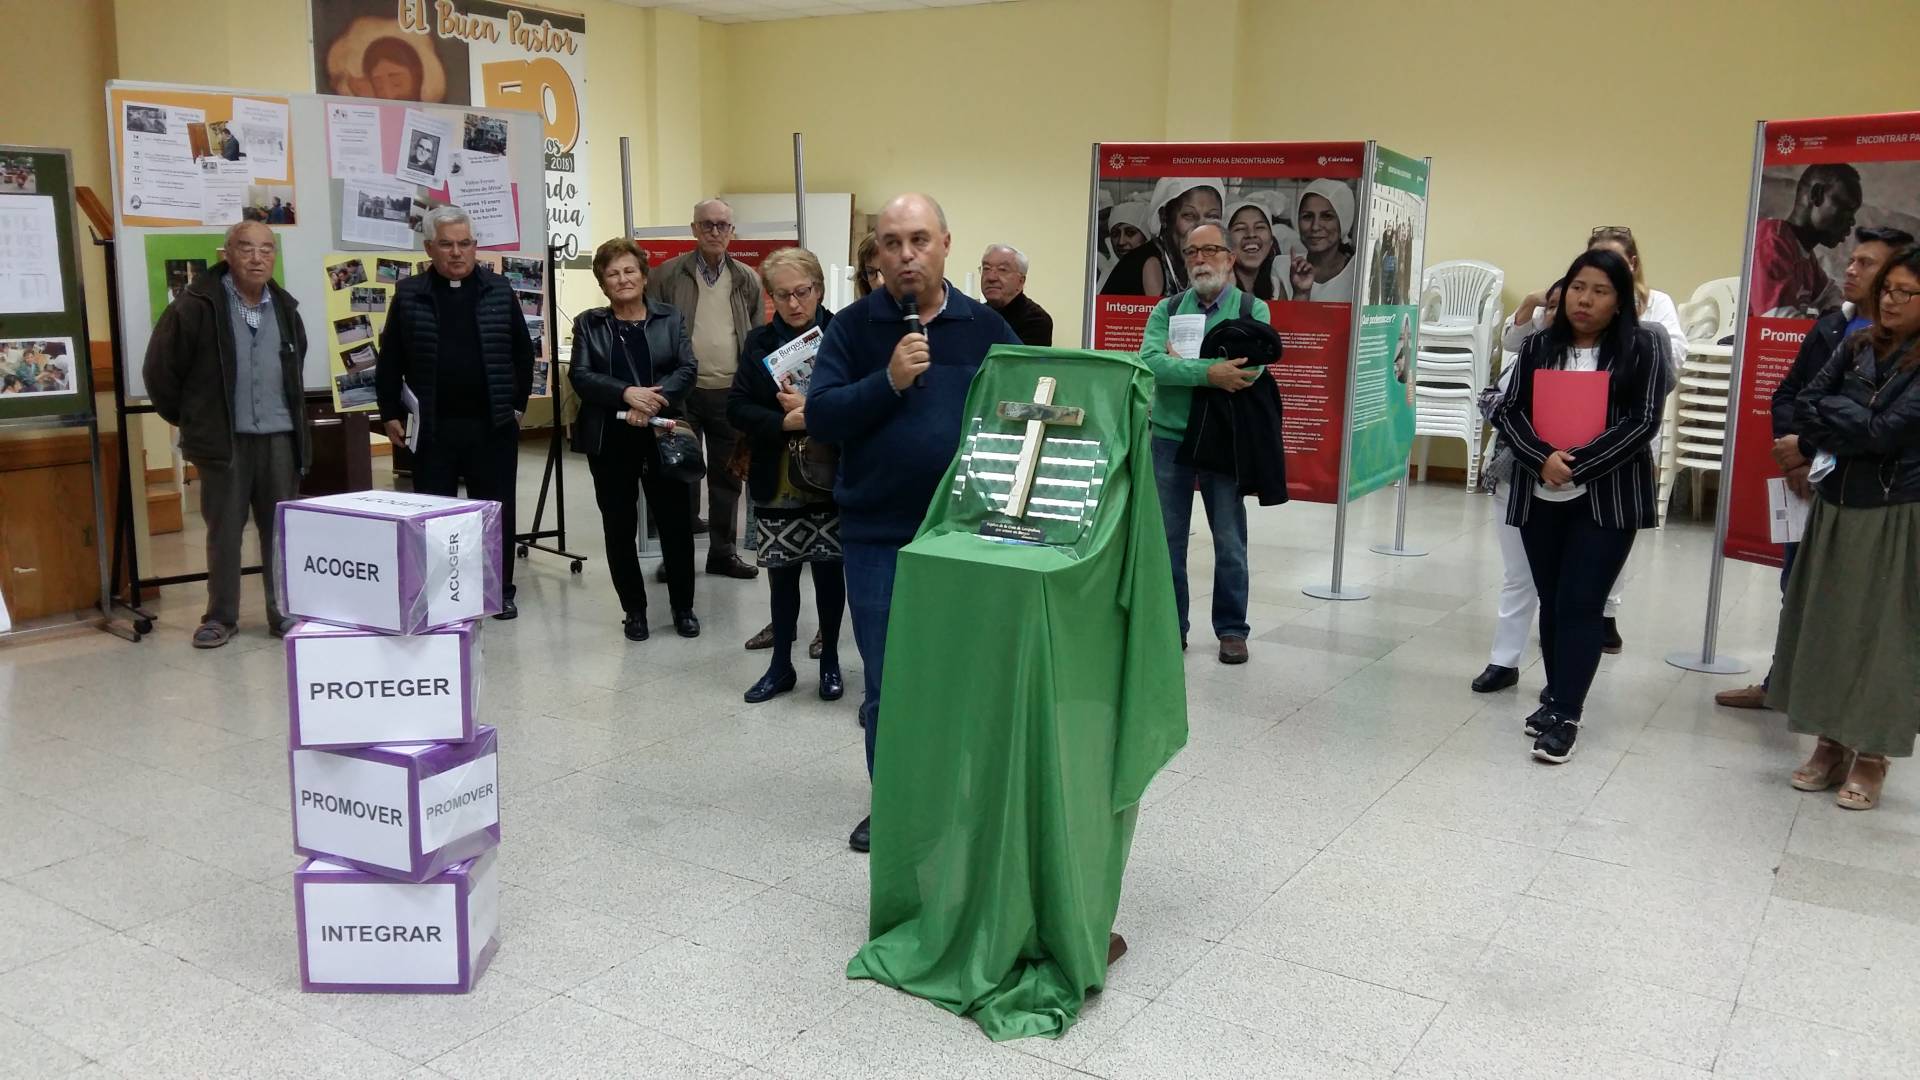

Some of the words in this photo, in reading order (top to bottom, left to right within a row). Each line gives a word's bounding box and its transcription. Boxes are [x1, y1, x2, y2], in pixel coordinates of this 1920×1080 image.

[400, 0, 427, 31] El
[437, 2, 500, 43] Buen
[508, 12, 578, 55] Pastor
[1856, 134, 1908, 144] ENCONTRAR
[1909, 133, 1920, 142] PA
[1106, 301, 1155, 315] Integram
[1760, 328, 1807, 343] Promo
[304, 555, 380, 583] ACOGER
[449, 532, 460, 602] ACOGER
[310, 678, 450, 700] PROTEGER
[302, 790, 403, 826] PROMOVER
[425, 783, 494, 820] PROMOVER
[321, 925, 442, 943] INTEGRAR
